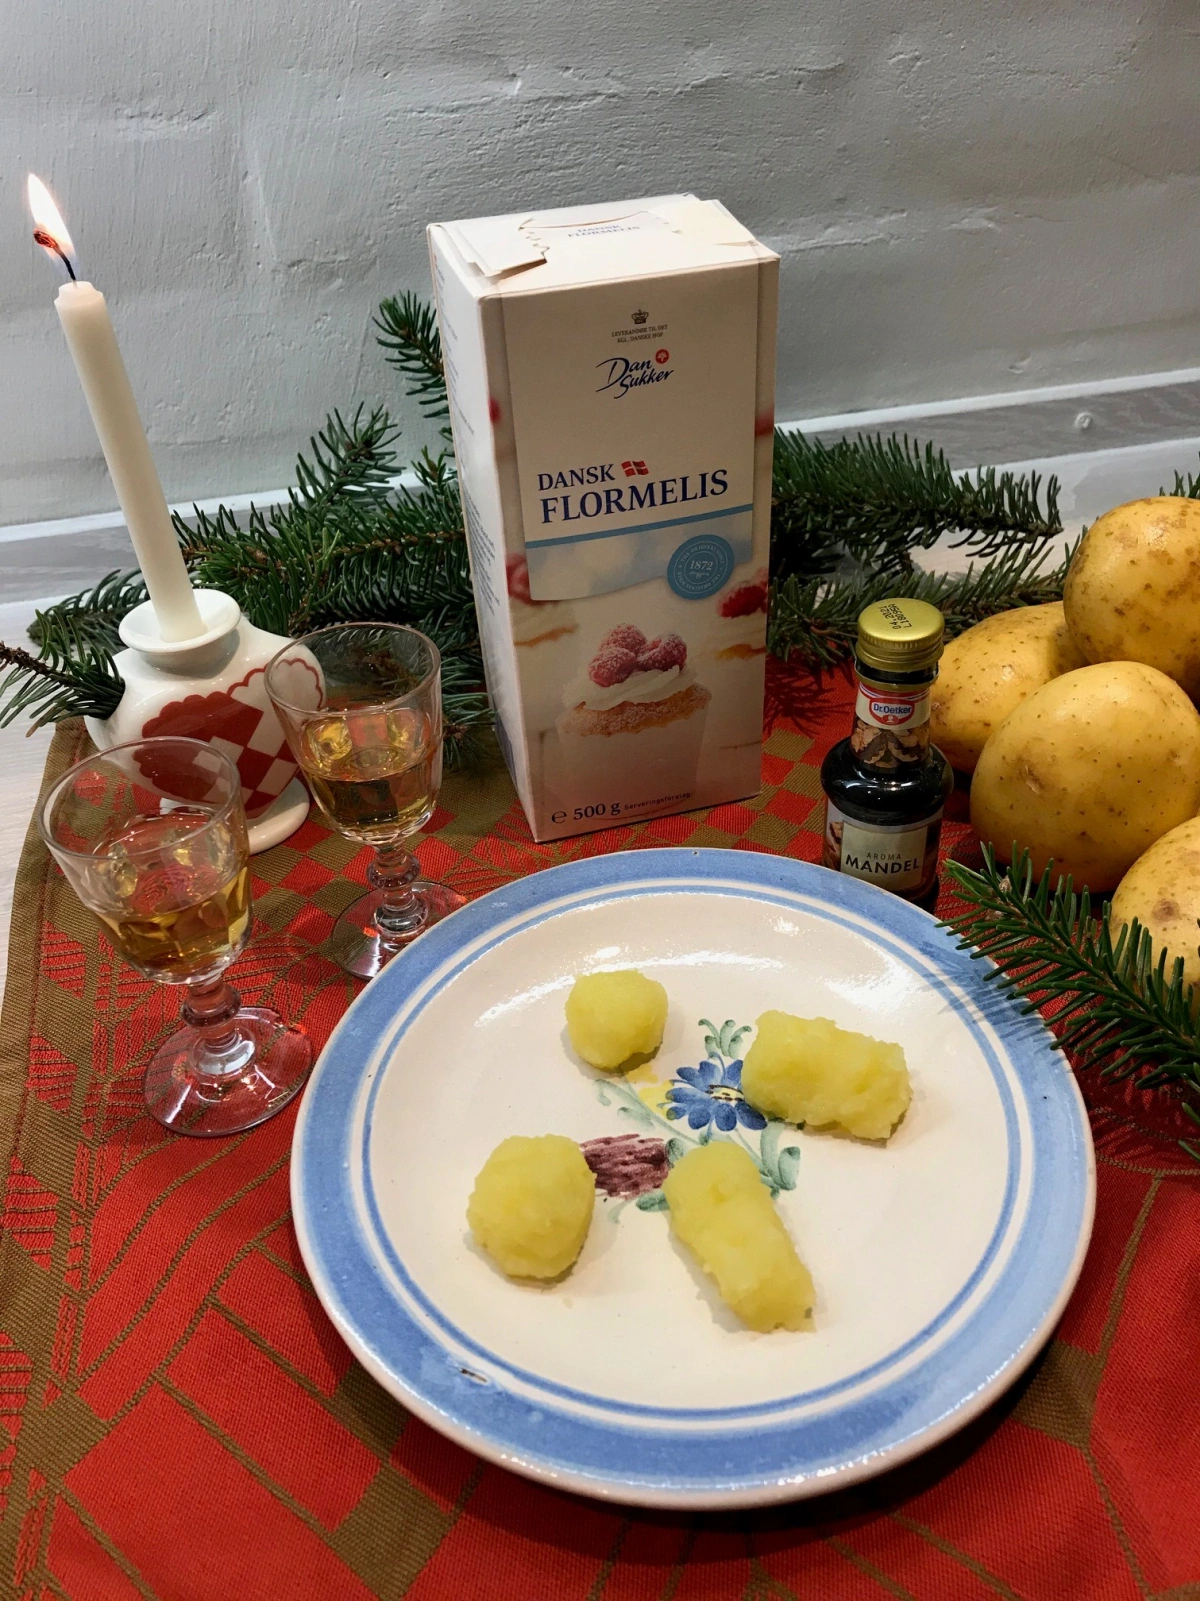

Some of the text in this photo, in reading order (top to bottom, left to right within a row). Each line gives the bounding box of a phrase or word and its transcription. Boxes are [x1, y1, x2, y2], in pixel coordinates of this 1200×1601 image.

[595, 357, 653, 393] Dan
[613, 369, 674, 399] Sukker
[537, 463, 616, 491] DANSK
[541, 469, 728, 523] FLORMELIS
[690, 560, 714, 571] 1872
[573, 803, 606, 820] 500
[610, 802, 621, 816] g
[845, 854, 919, 874] MANDEL
[866, 852, 902, 861] AROMA
